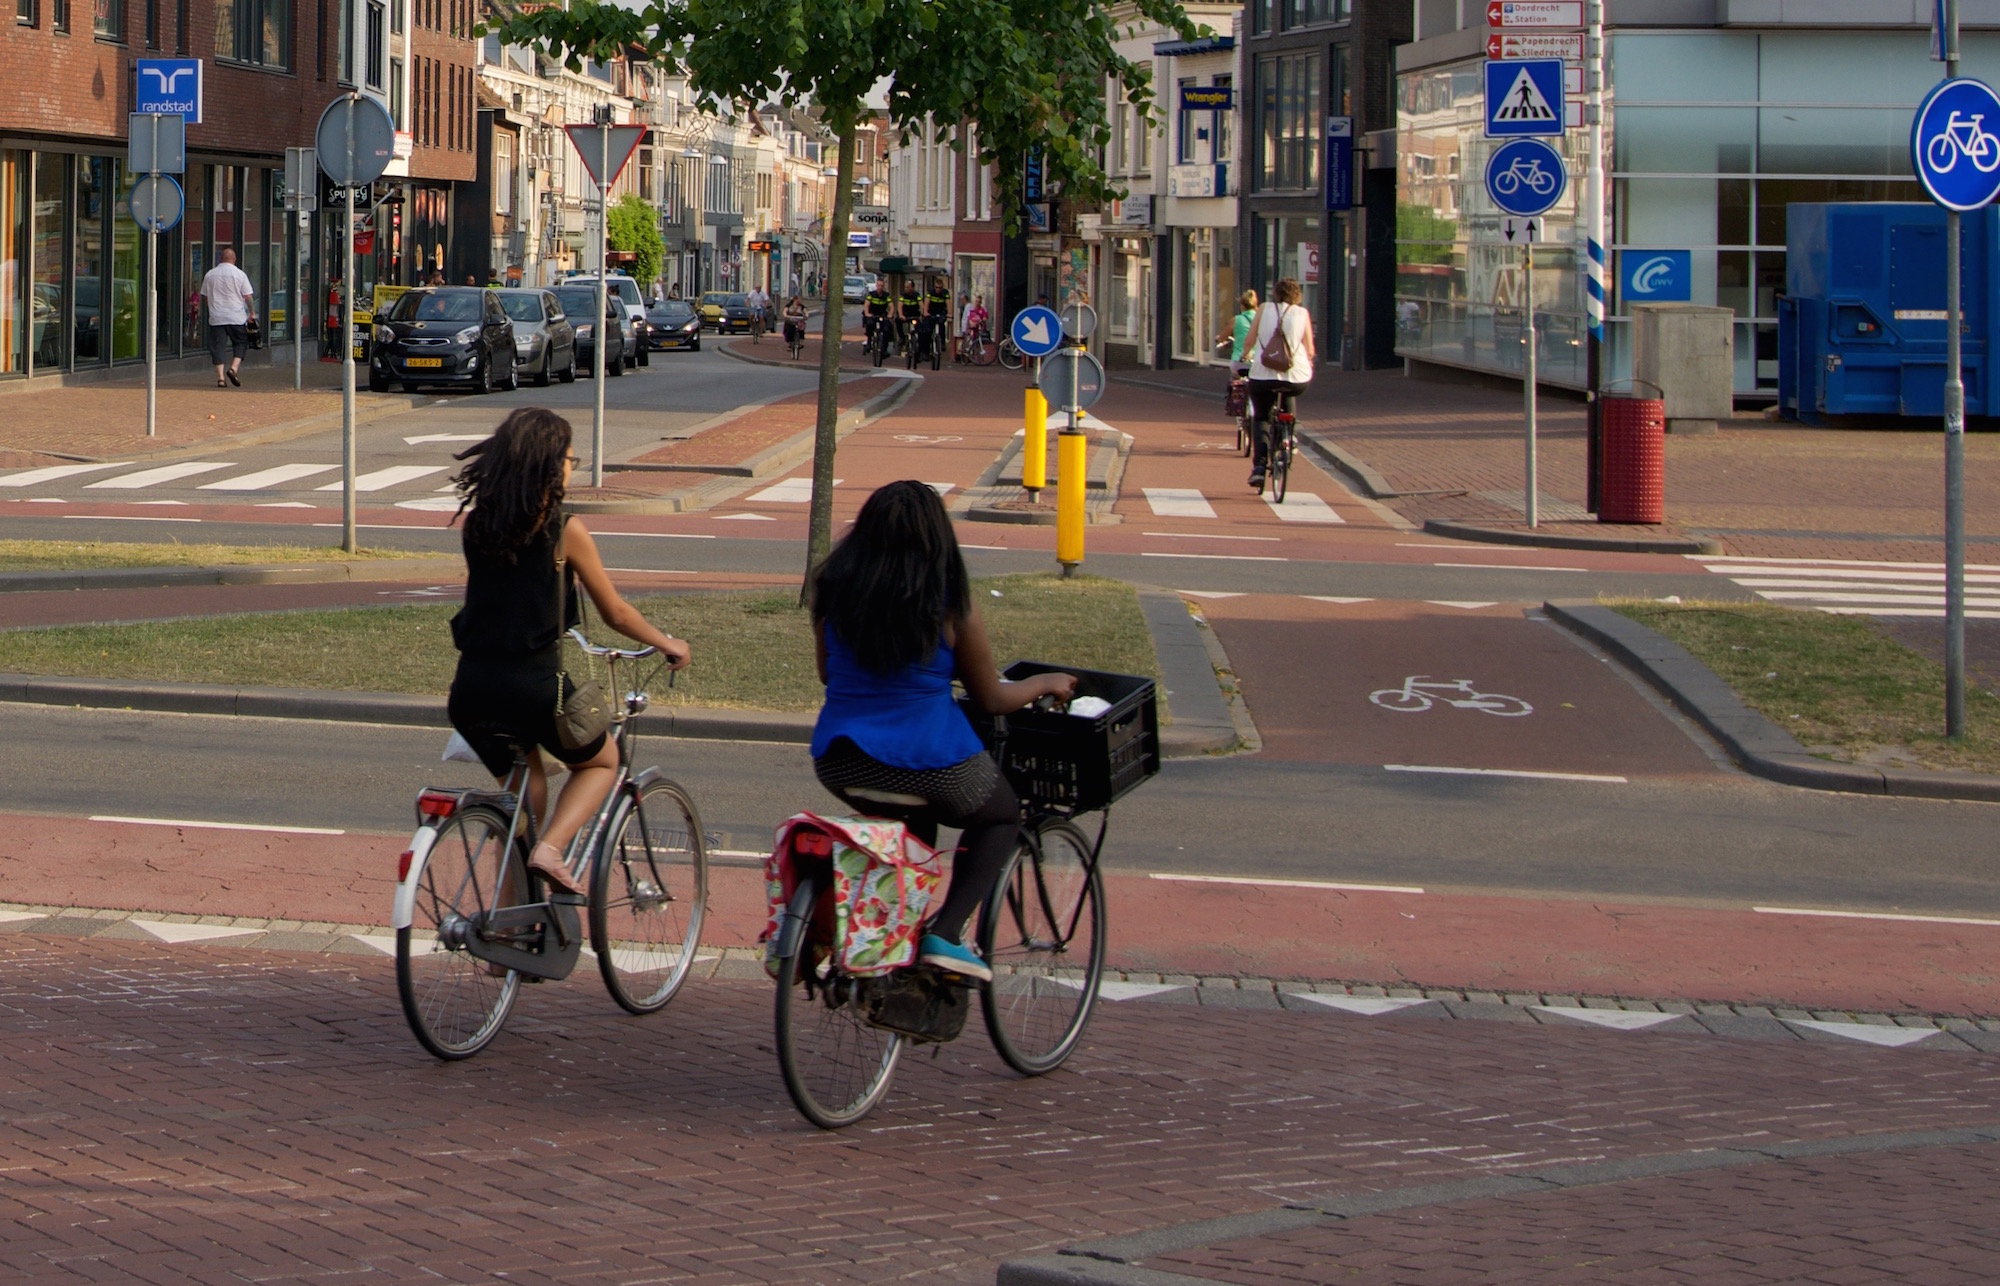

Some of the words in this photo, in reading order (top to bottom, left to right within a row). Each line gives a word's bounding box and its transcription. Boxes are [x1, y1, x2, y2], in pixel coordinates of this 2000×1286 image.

[1515, 4, 1560, 12] Dordrecht
[1515, 15, 1547, 23] Station
[1521, 37, 1580, 46] Papendrecht
[1521, 49, 1570, 57] Sliedrecht
[1184, 92, 1228, 105] Wrangler
[142, 99, 194, 112] randstad
[1331, 142, 1340, 204] Ingenieursbureau
[328, 185, 368, 203] SPUEG
[857, 213, 888, 225] sonja
